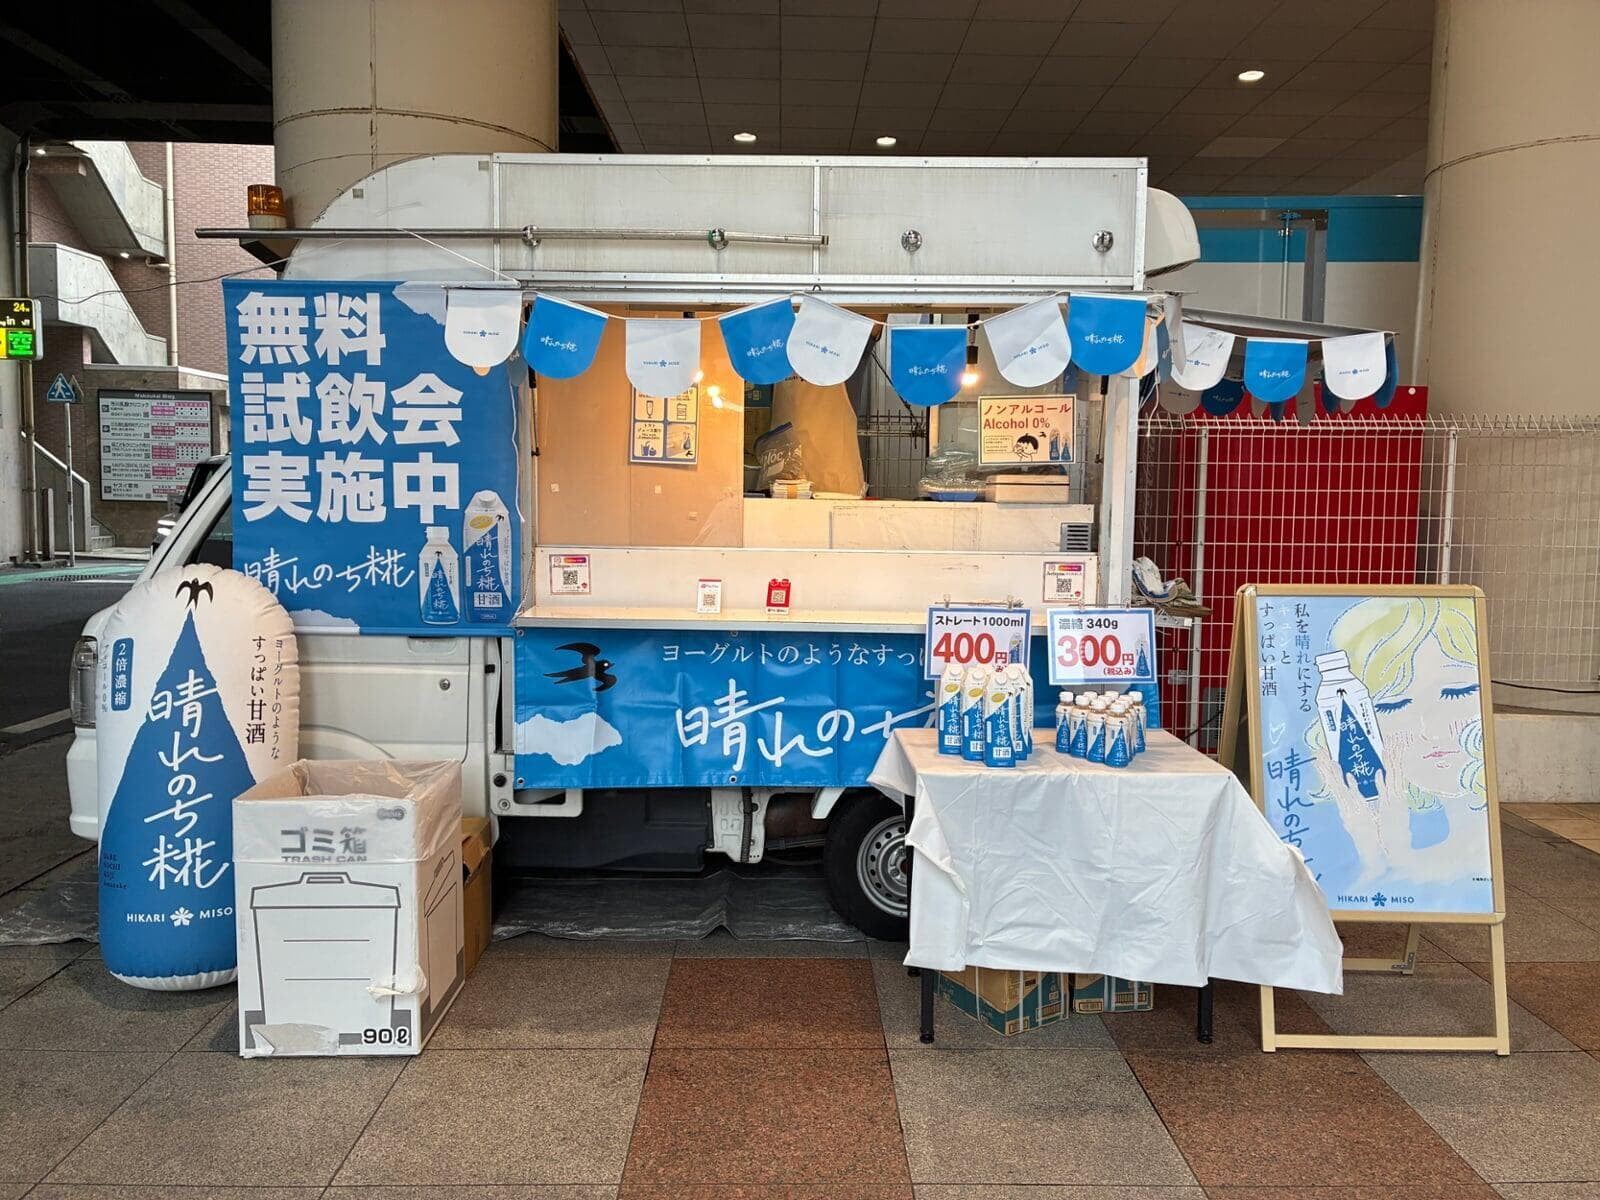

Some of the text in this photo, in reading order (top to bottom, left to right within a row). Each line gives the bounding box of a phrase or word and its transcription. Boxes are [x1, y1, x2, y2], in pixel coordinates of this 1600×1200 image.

[236, 291, 386, 365] 無料
[240, 372, 464, 447] 試飲会
[983, 417, 1050, 429] Alcohol 0%
[984, 403, 1071, 415] ノンアルコール
[242, 450, 461, 524] 実施中
[244, 545, 415, 596] 晴れのち糀
[475, 533, 500, 591] 晴れのち糀
[478, 593, 500, 606] 甘酒
[1087, 618, 1119, 630] 340g
[115, 643, 128, 706] 2倍濃縮
[663, 642, 925, 667] ヨーグルトのようなすっ
[1057, 634, 1134, 667] 300円
[1103, 667, 1136, 676] (税込み)
[1295, 603, 1313, 712] 私を晴れにする
[246, 636, 267, 744] すっぱい甘酒
[272, 639, 283, 760] ヨーグルトのような
[1340, 714, 1374, 777] 晴れのち糀
[142, 669, 229, 890] 晴れのち糀
[281, 826, 367, 854] ゴミ箱
[1268, 748, 1321, 881] 晴れのち
[127, 907, 233, 922] HIKARI MISO
[1337, 895, 1368, 903] HIKARI
